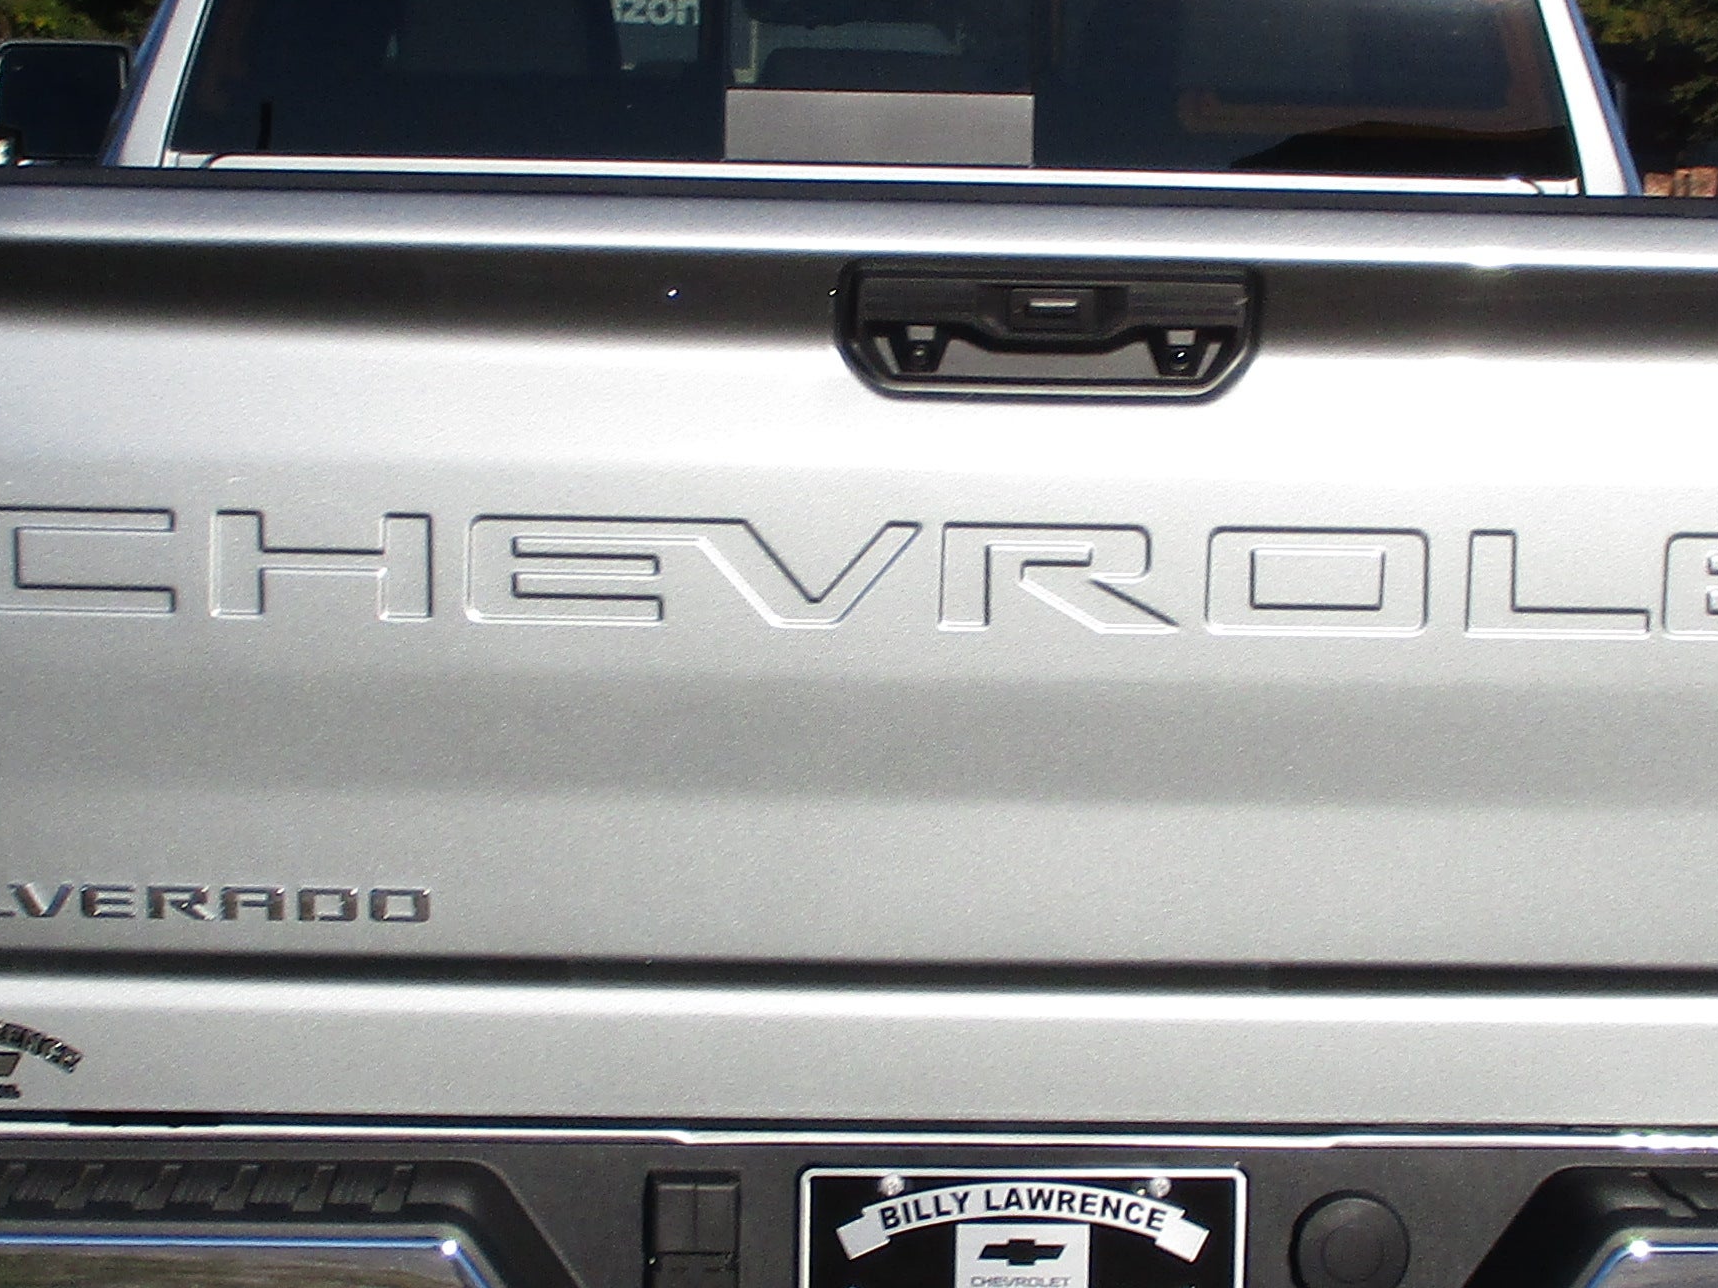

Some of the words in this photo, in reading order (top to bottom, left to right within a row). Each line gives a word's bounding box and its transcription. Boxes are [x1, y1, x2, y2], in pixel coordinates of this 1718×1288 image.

[880, 1190, 971, 1230] BILLY
[984, 1187, 1168, 1231] LAWRENCE
[970, 1276, 1071, 1288] CHEVROLET
